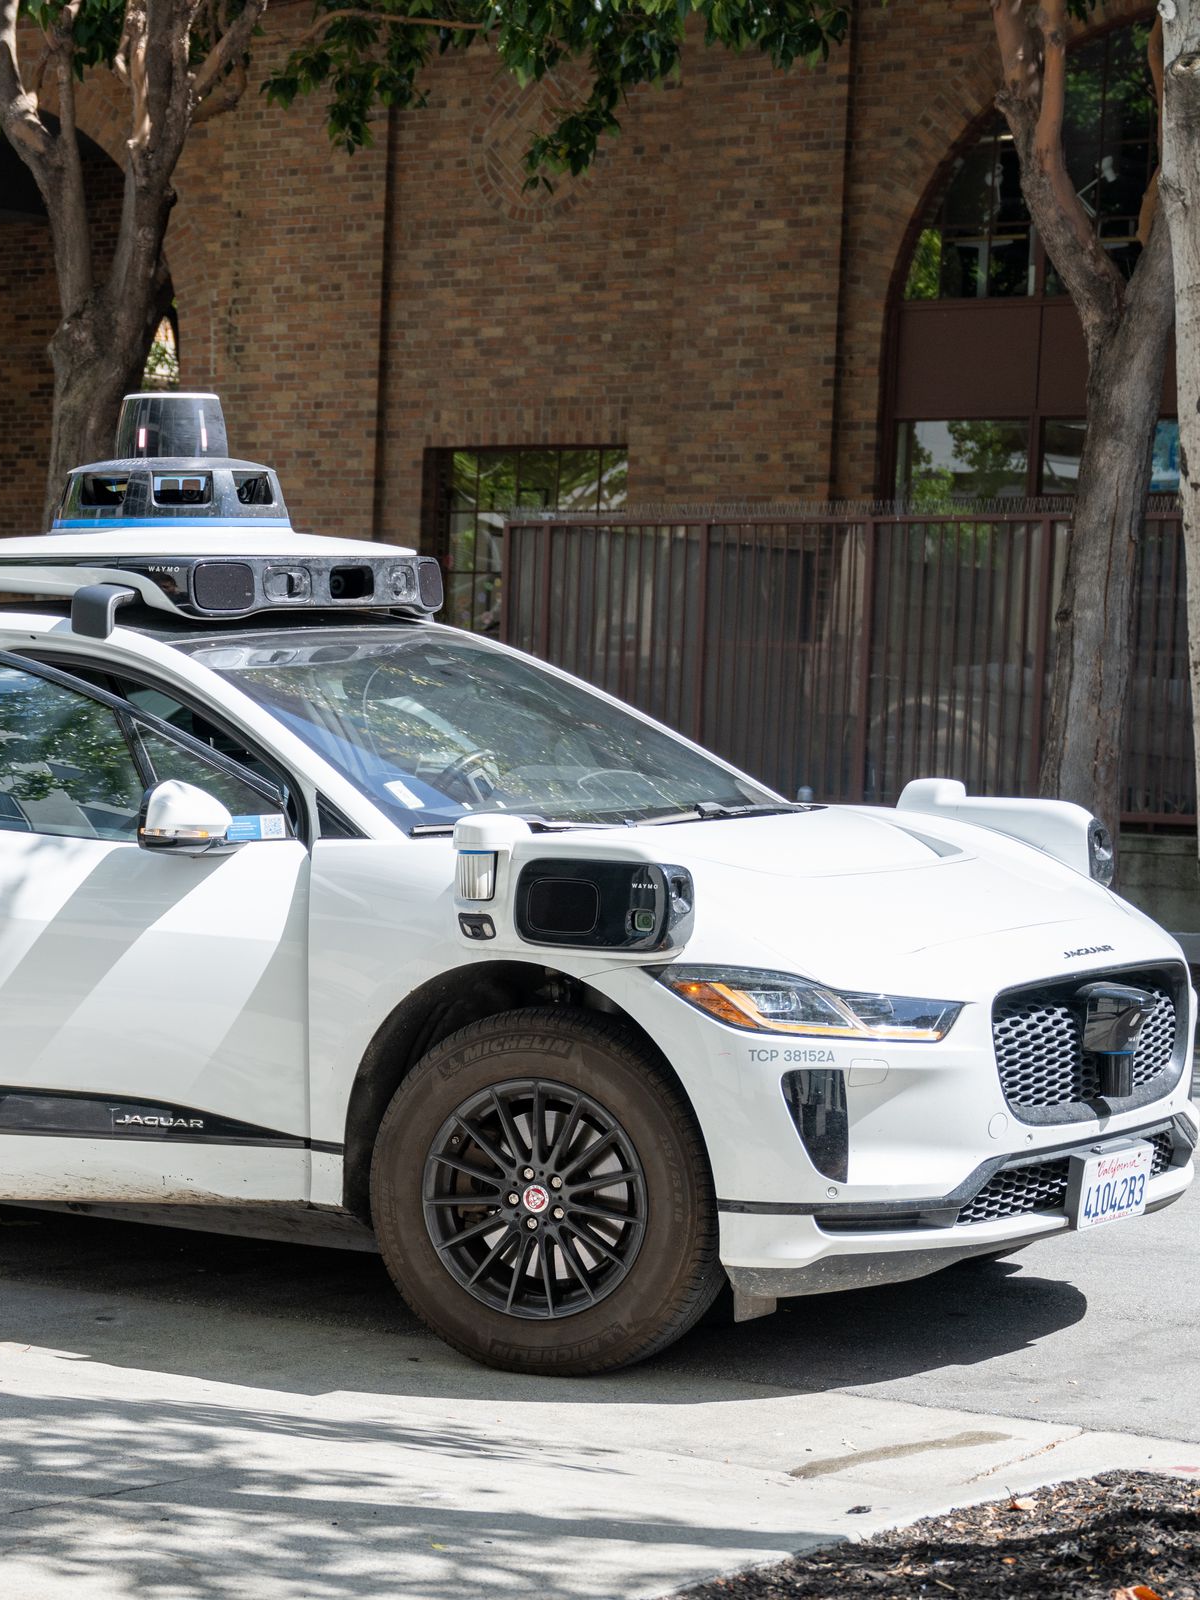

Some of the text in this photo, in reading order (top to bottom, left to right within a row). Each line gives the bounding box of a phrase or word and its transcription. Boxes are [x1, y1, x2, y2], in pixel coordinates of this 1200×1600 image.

[1064, 945, 1114, 959] JAGUAR
[464, 1036, 572, 1061] MICHELIN
[748, 1050, 835, 1062] TCP 38152A
[115, 1114, 204, 1128] JAGUAR
[1097, 1157, 1140, 1179] California
[1084, 1174, 1145, 1219] 41042B3
